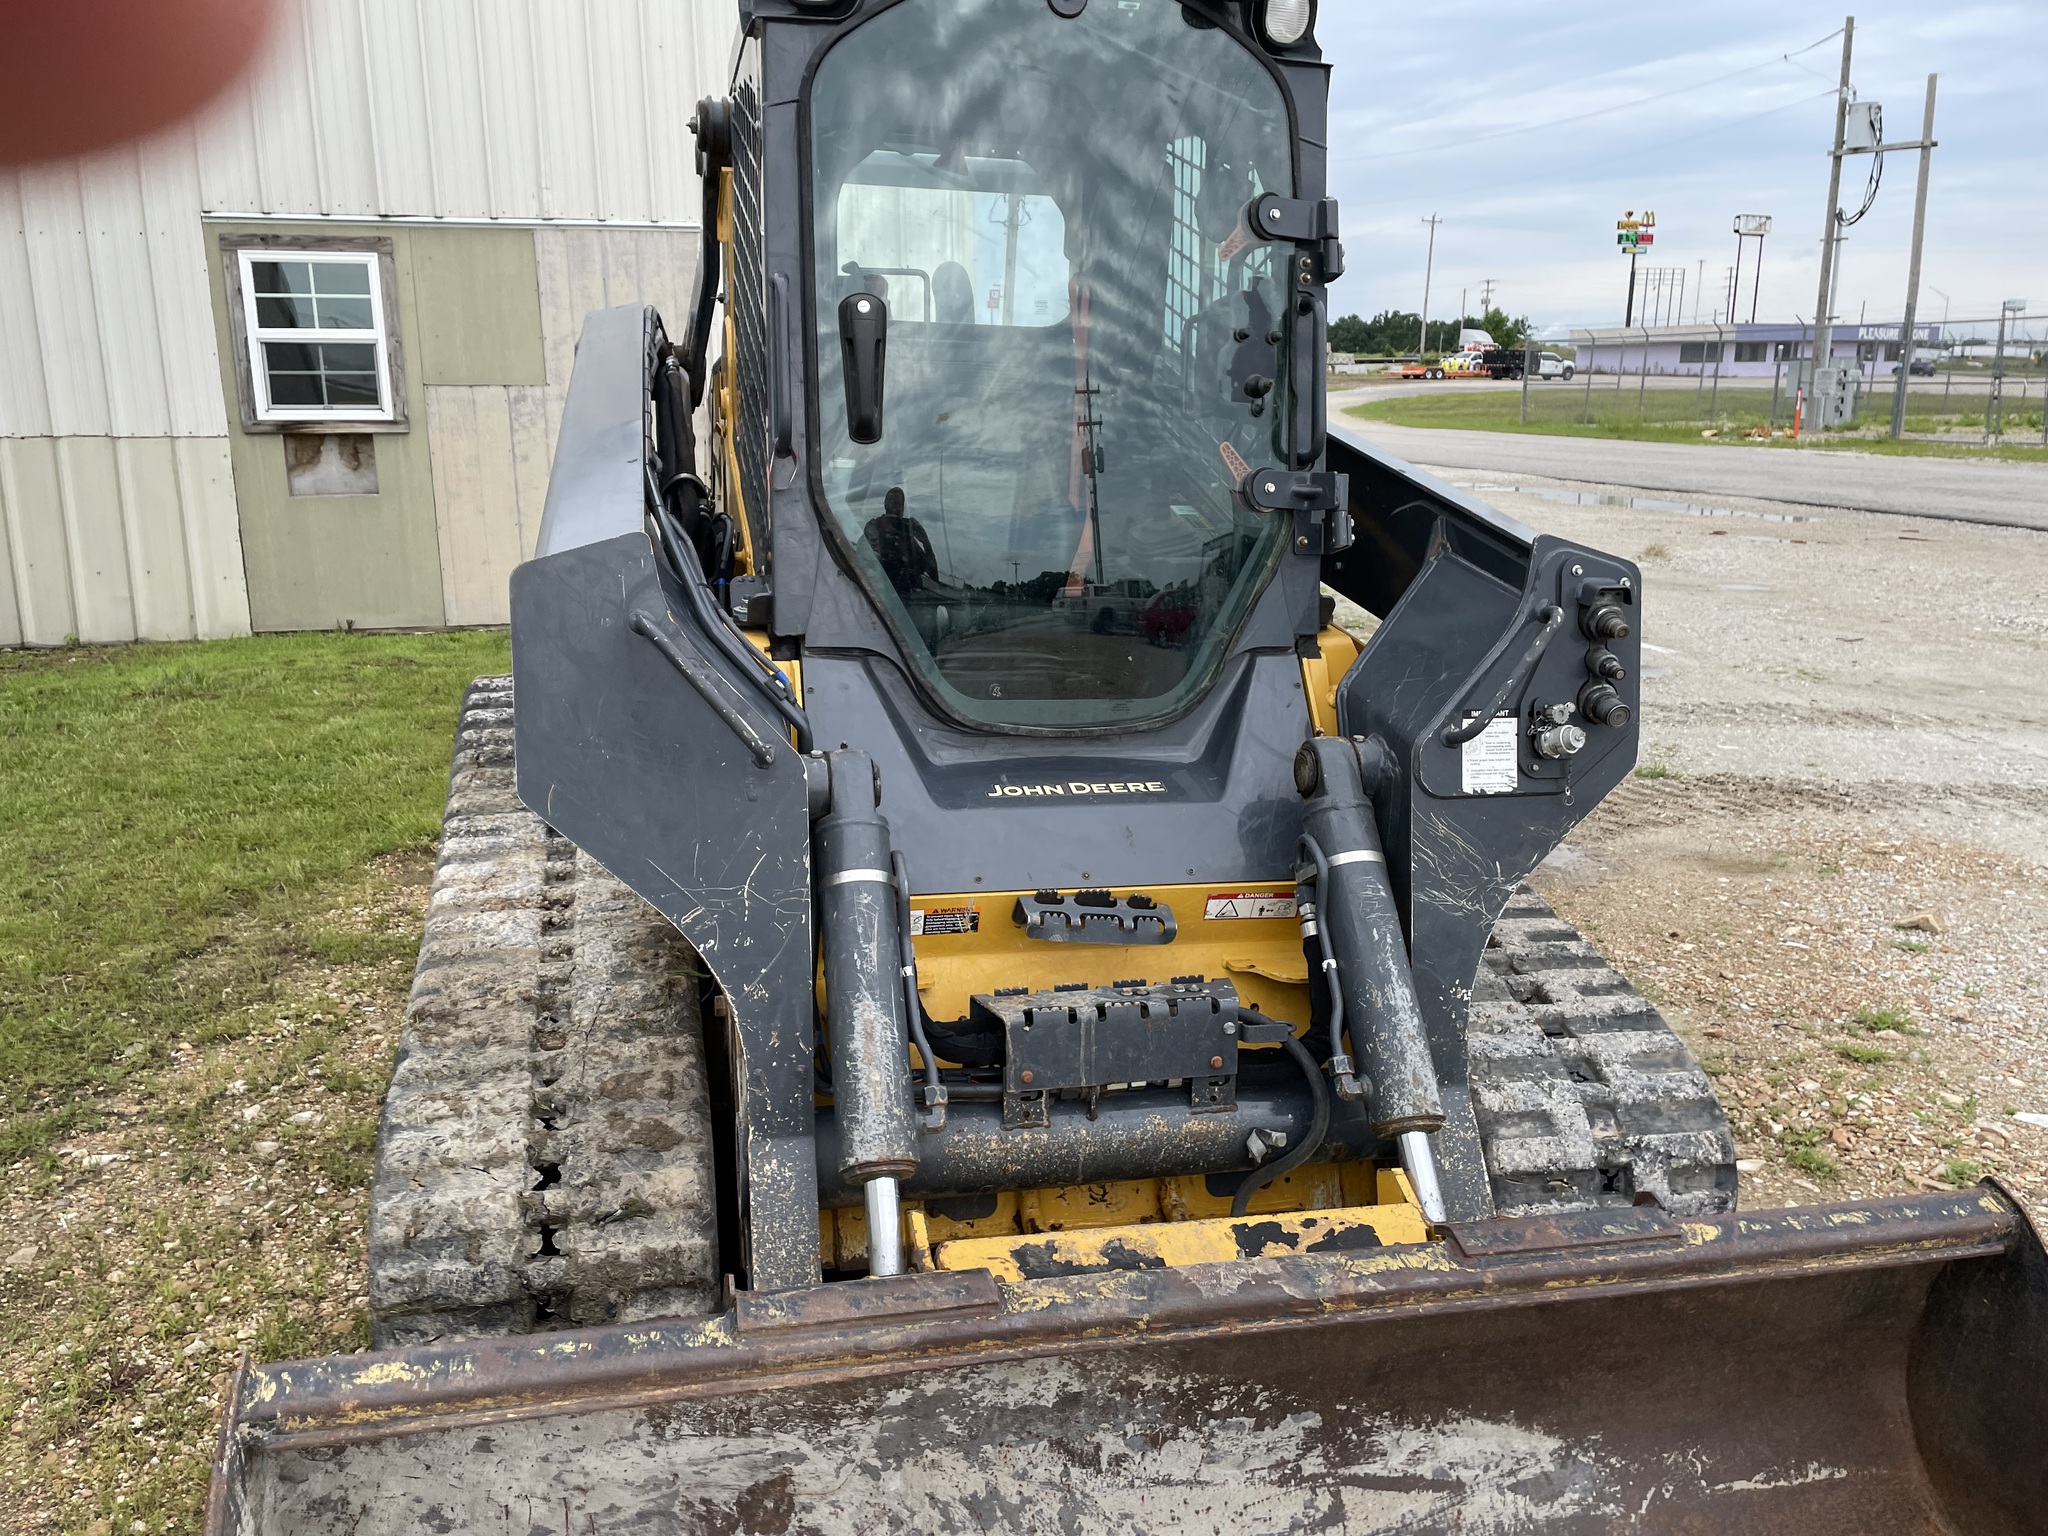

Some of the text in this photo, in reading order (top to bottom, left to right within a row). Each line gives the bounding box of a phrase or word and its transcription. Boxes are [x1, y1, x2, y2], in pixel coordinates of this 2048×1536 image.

[1858, 326, 1930, 340] PLEASURE ONE
[987, 781, 1165, 797] JOHN DEERE
